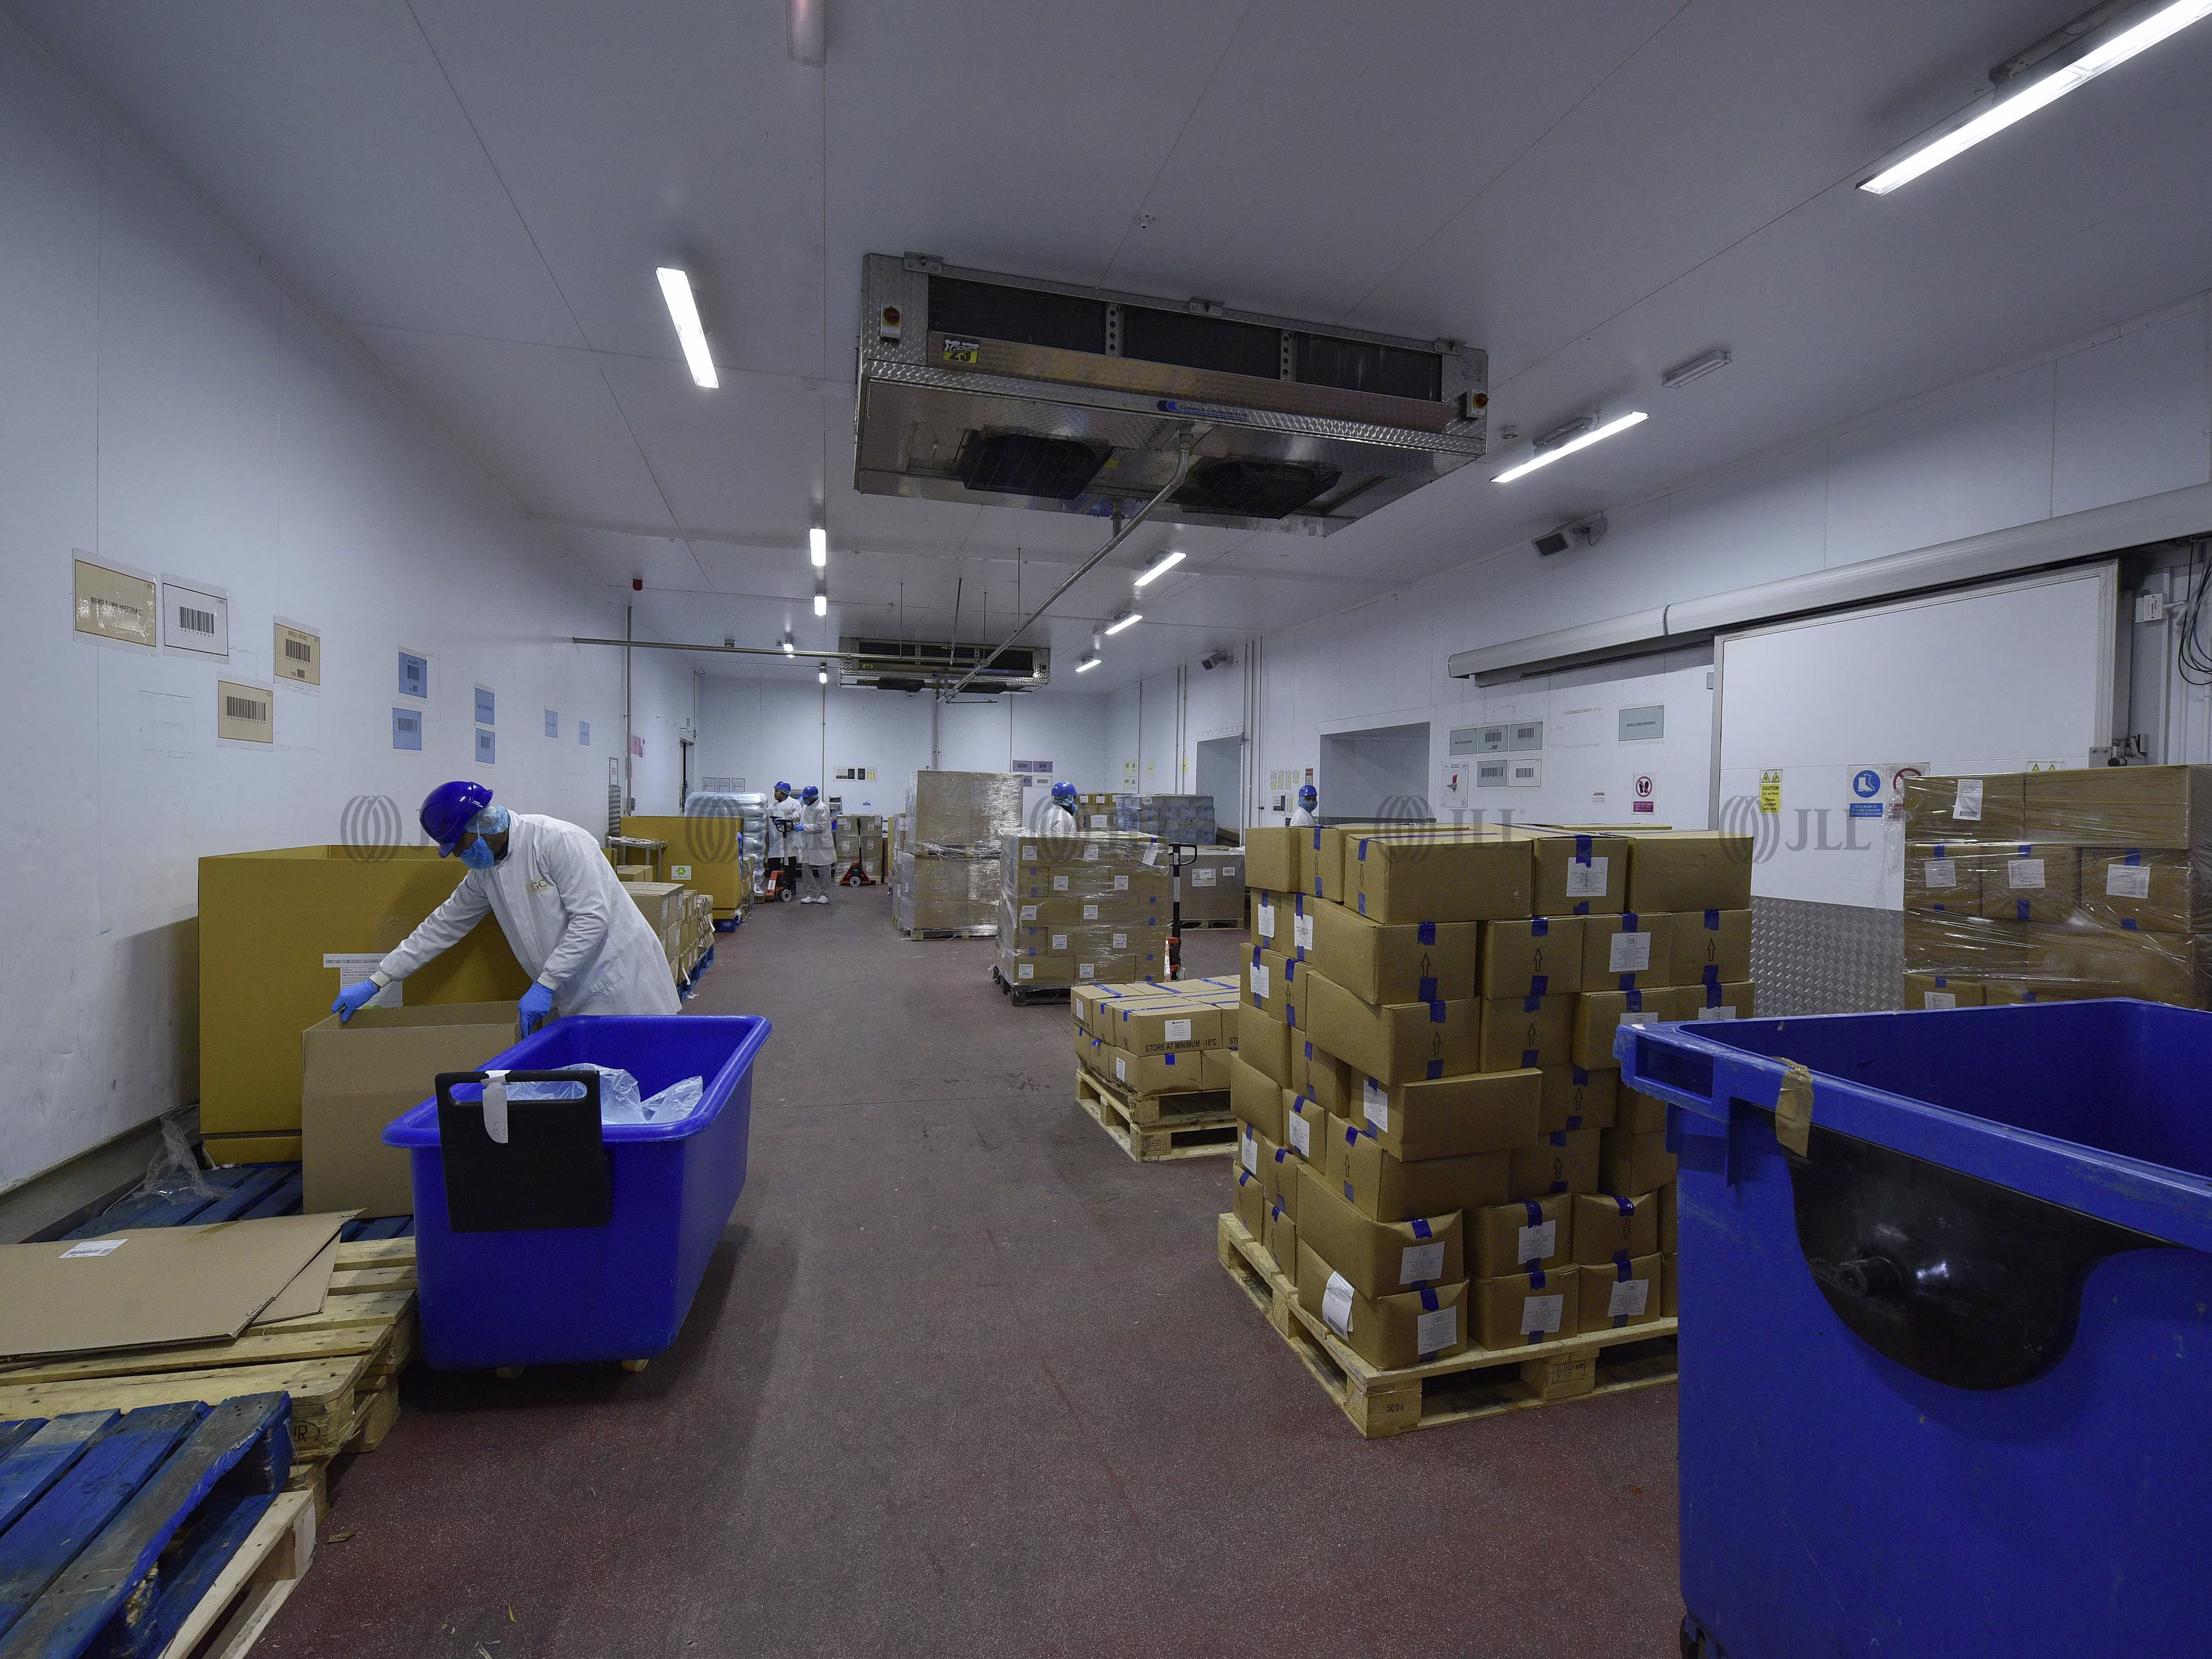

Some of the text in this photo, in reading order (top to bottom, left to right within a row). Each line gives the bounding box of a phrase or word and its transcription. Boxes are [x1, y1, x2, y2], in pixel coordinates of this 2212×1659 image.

[949, 350, 971, 362] 23
[1207, 408, 1237, 416] Condensers
[90, 597, 104, 605] BILBO
[119, 604, 143, 615] MATERIALS
[1145, 1043, 1165, 1052] STORE
[1175, 1040, 1200, 1050] MINIMUM
[1387, 1403, 1404, 1412] 5094
